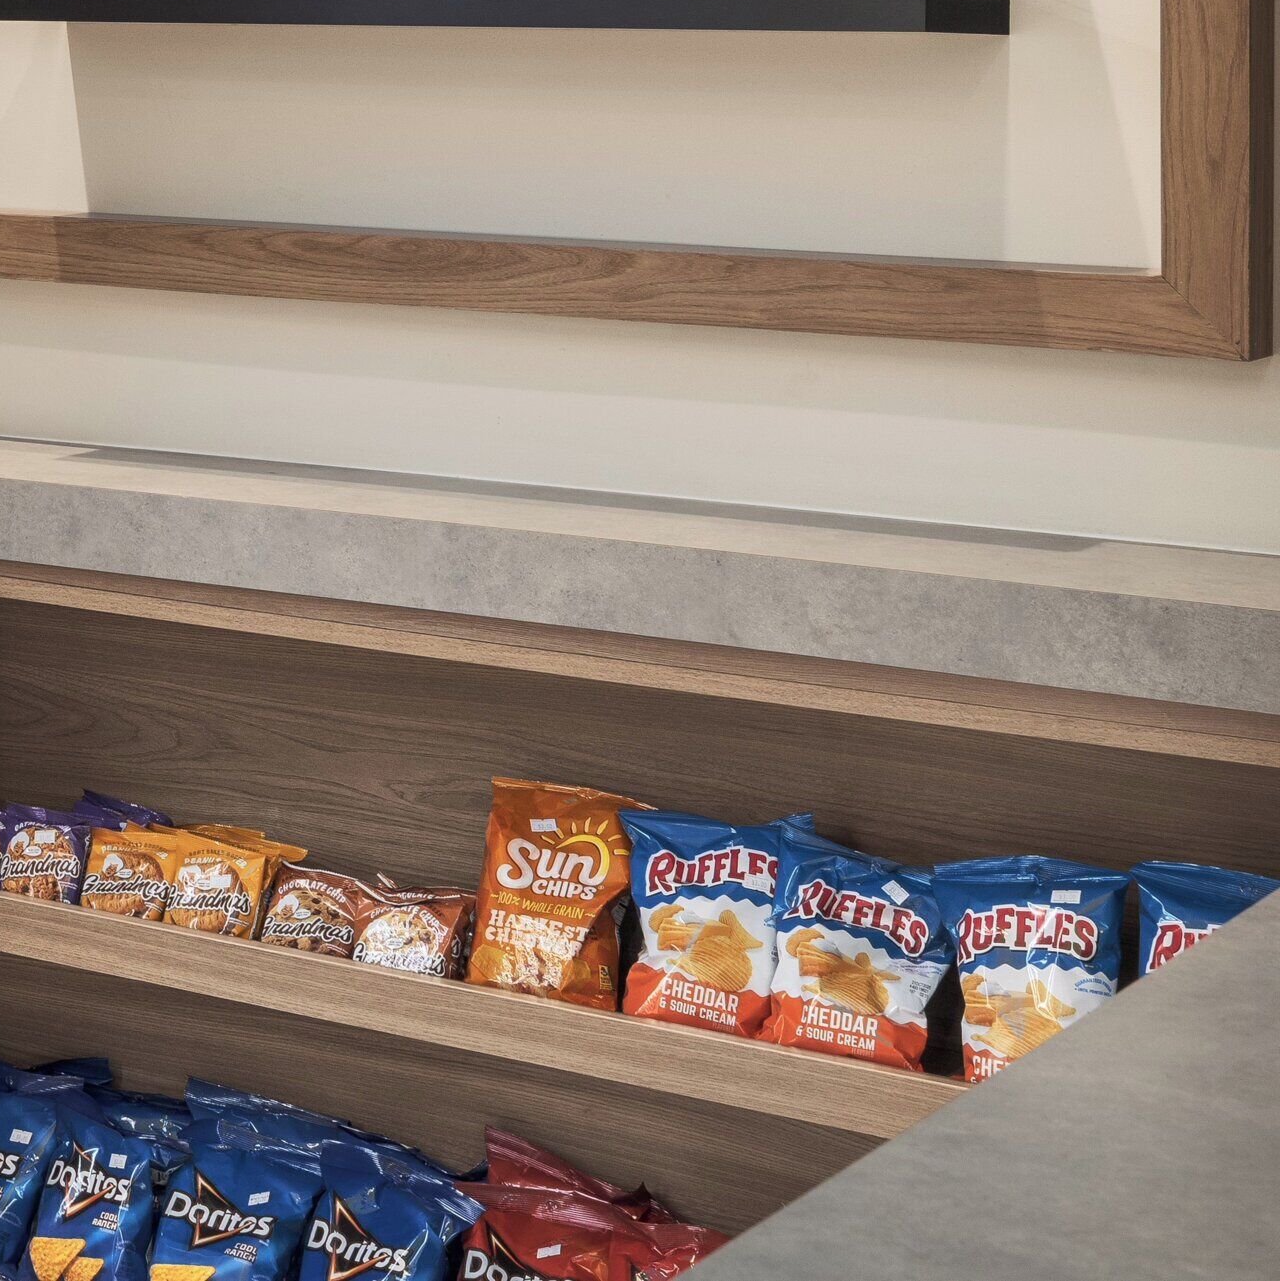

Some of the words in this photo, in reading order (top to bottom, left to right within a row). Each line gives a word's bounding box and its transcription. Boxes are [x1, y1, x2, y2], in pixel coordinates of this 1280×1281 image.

[0, 855, 80, 879] Grandma's
[497, 838, 604, 889] Sun
[647, 847, 778, 895] RUFFLES
[83, 875, 170, 901] Grandma's
[532, 879, 596, 900] CHIPS
[498, 891, 520, 905] 100%
[522, 897, 554, 914] WHOLE
[554, 904, 584, 919] GRAIN
[785, 879, 930, 957] RUFFLES
[957, 904, 1098, 964] RUFFLES
[661, 978, 739, 1013] CHEDDAR
[659, 997, 667, 1008] &
[670, 999, 697, 1018] SOUR
[699, 1006, 737, 1027] CREAM
[801, 1005, 877, 1037] CHEDDAR
[806, 1027, 834, 1045] SOUR
[837, 1033, 875, 1051] CREAM
[92, 1218, 118, 1231] RANCH
[99, 1211, 119, 1223] COOL
[164, 1190, 274, 1238] Doritos
[308, 1219, 408, 1276] Doritos
